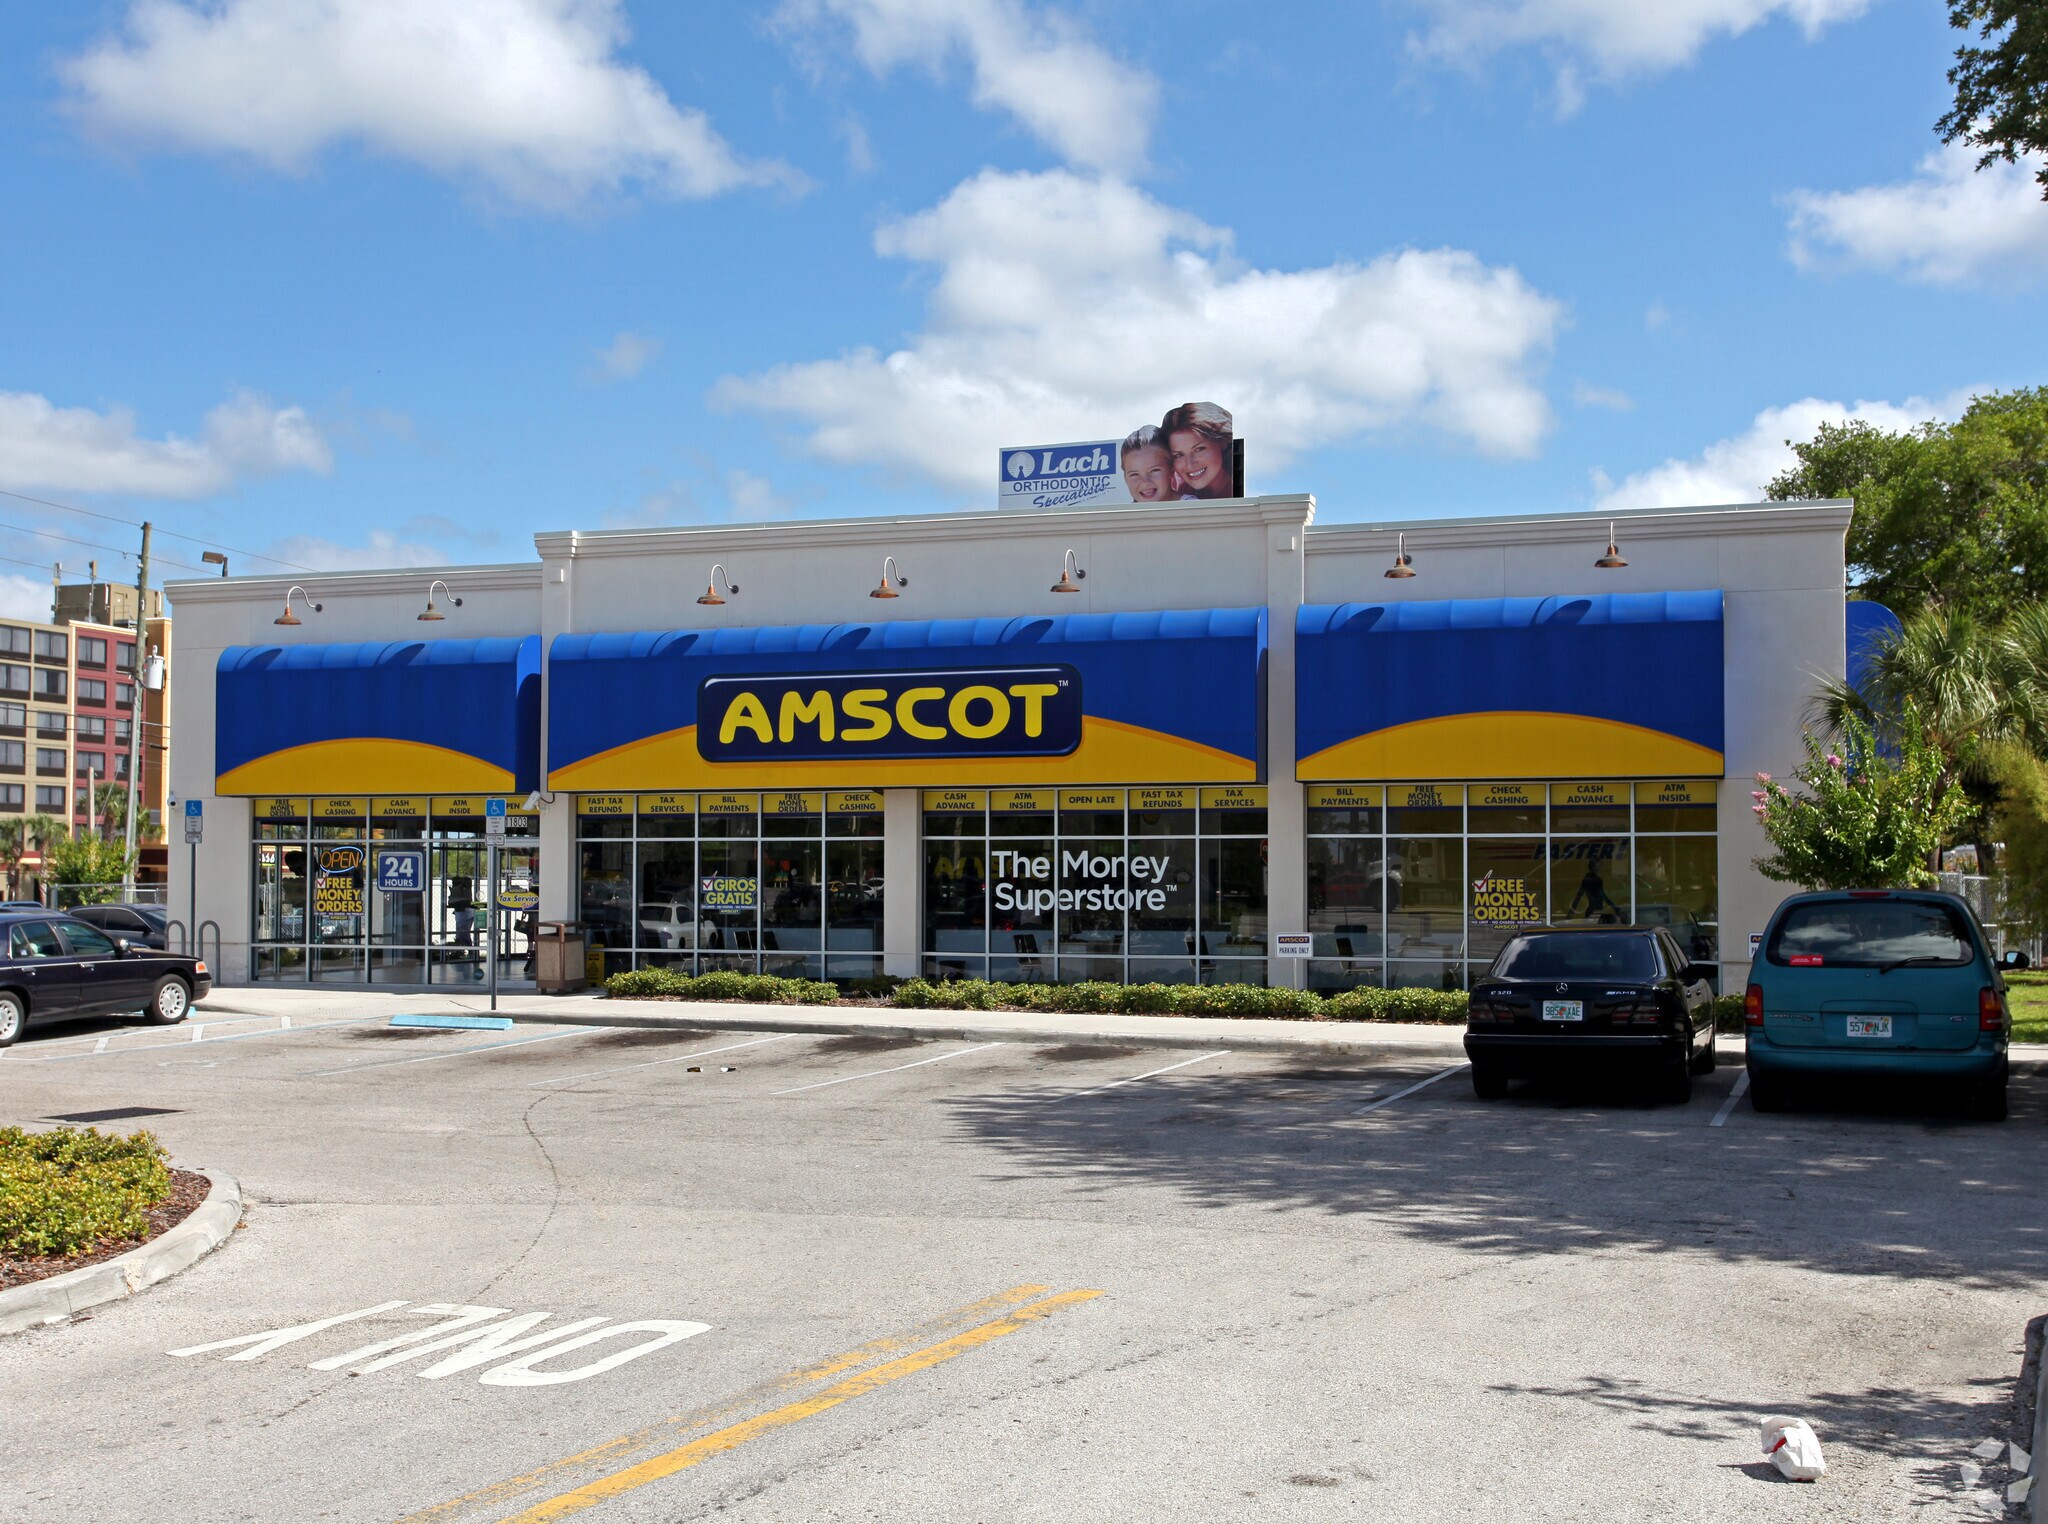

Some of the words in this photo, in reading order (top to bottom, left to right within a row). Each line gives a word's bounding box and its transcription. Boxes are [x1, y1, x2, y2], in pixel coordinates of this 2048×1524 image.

[1040, 447, 1110, 475] Lach
[1013, 475, 1111, 493] ORTHODONTIC
[1032, 482, 1109, 509] Specialists
[718, 683, 1059, 745] AMSCOT
[1415, 785, 1435, 793] FREE
[1490, 786, 1522, 794] CHECK
[1576, 785, 1604, 793] CASH
[1664, 783, 1686, 792] ATM
[944, 792, 967, 800] CASH
[1014, 792, 1032, 800] ATM
[1141, 790, 1161, 798] FAST
[1166, 790, 1183, 798] TAX
[1225, 789, 1243, 797] TAX
[1336, 788, 1354, 796] BILL
[1407, 792, 1442, 800] MONEY
[587, 797, 605, 805] FAST
[1068, 796, 1093, 804] OPEN
[1096, 796, 1116, 804] LATE
[1484, 796, 1529, 804] CASHING
[1567, 795, 1614, 803] ADVANCE
[1658, 793, 1691, 802] INSIDE
[1009, 801, 1037, 809] INSIDE
[1142, 800, 1183, 808] REFUNDS
[1214, 799, 1255, 807] SERVICES
[1321, 798, 1370, 806] PAYMENTS
[1407, 799, 1443, 807] ORDERS
[448, 807, 471, 815] INSIDE
[650, 805, 685, 813] SERVICES
[709, 804, 750, 812] PAYMENTS
[839, 803, 876, 811] CASHING
[324, 808, 357, 816] CASHING
[320, 851, 360, 869] OPEN
[385, 857, 414, 877] 24
[991, 850, 1050, 878] The
[1063, 850, 1170, 884] Money
[326, 878, 353, 889] FREE
[384, 879, 413, 887] HOURS
[713, 879, 757, 892] GIROS
[1487, 879, 1524, 893] FREE
[316, 889, 361, 901] MONEY
[705, 892, 753, 905] GRATIS
[995, 883, 1166, 916] Superstore
[1474, 893, 1537, 906] MONEY
[316, 901, 363, 912] ORDERS
[1473, 906, 1540, 920] ORDERS
[164, 1300, 713, 1387] ONLY
